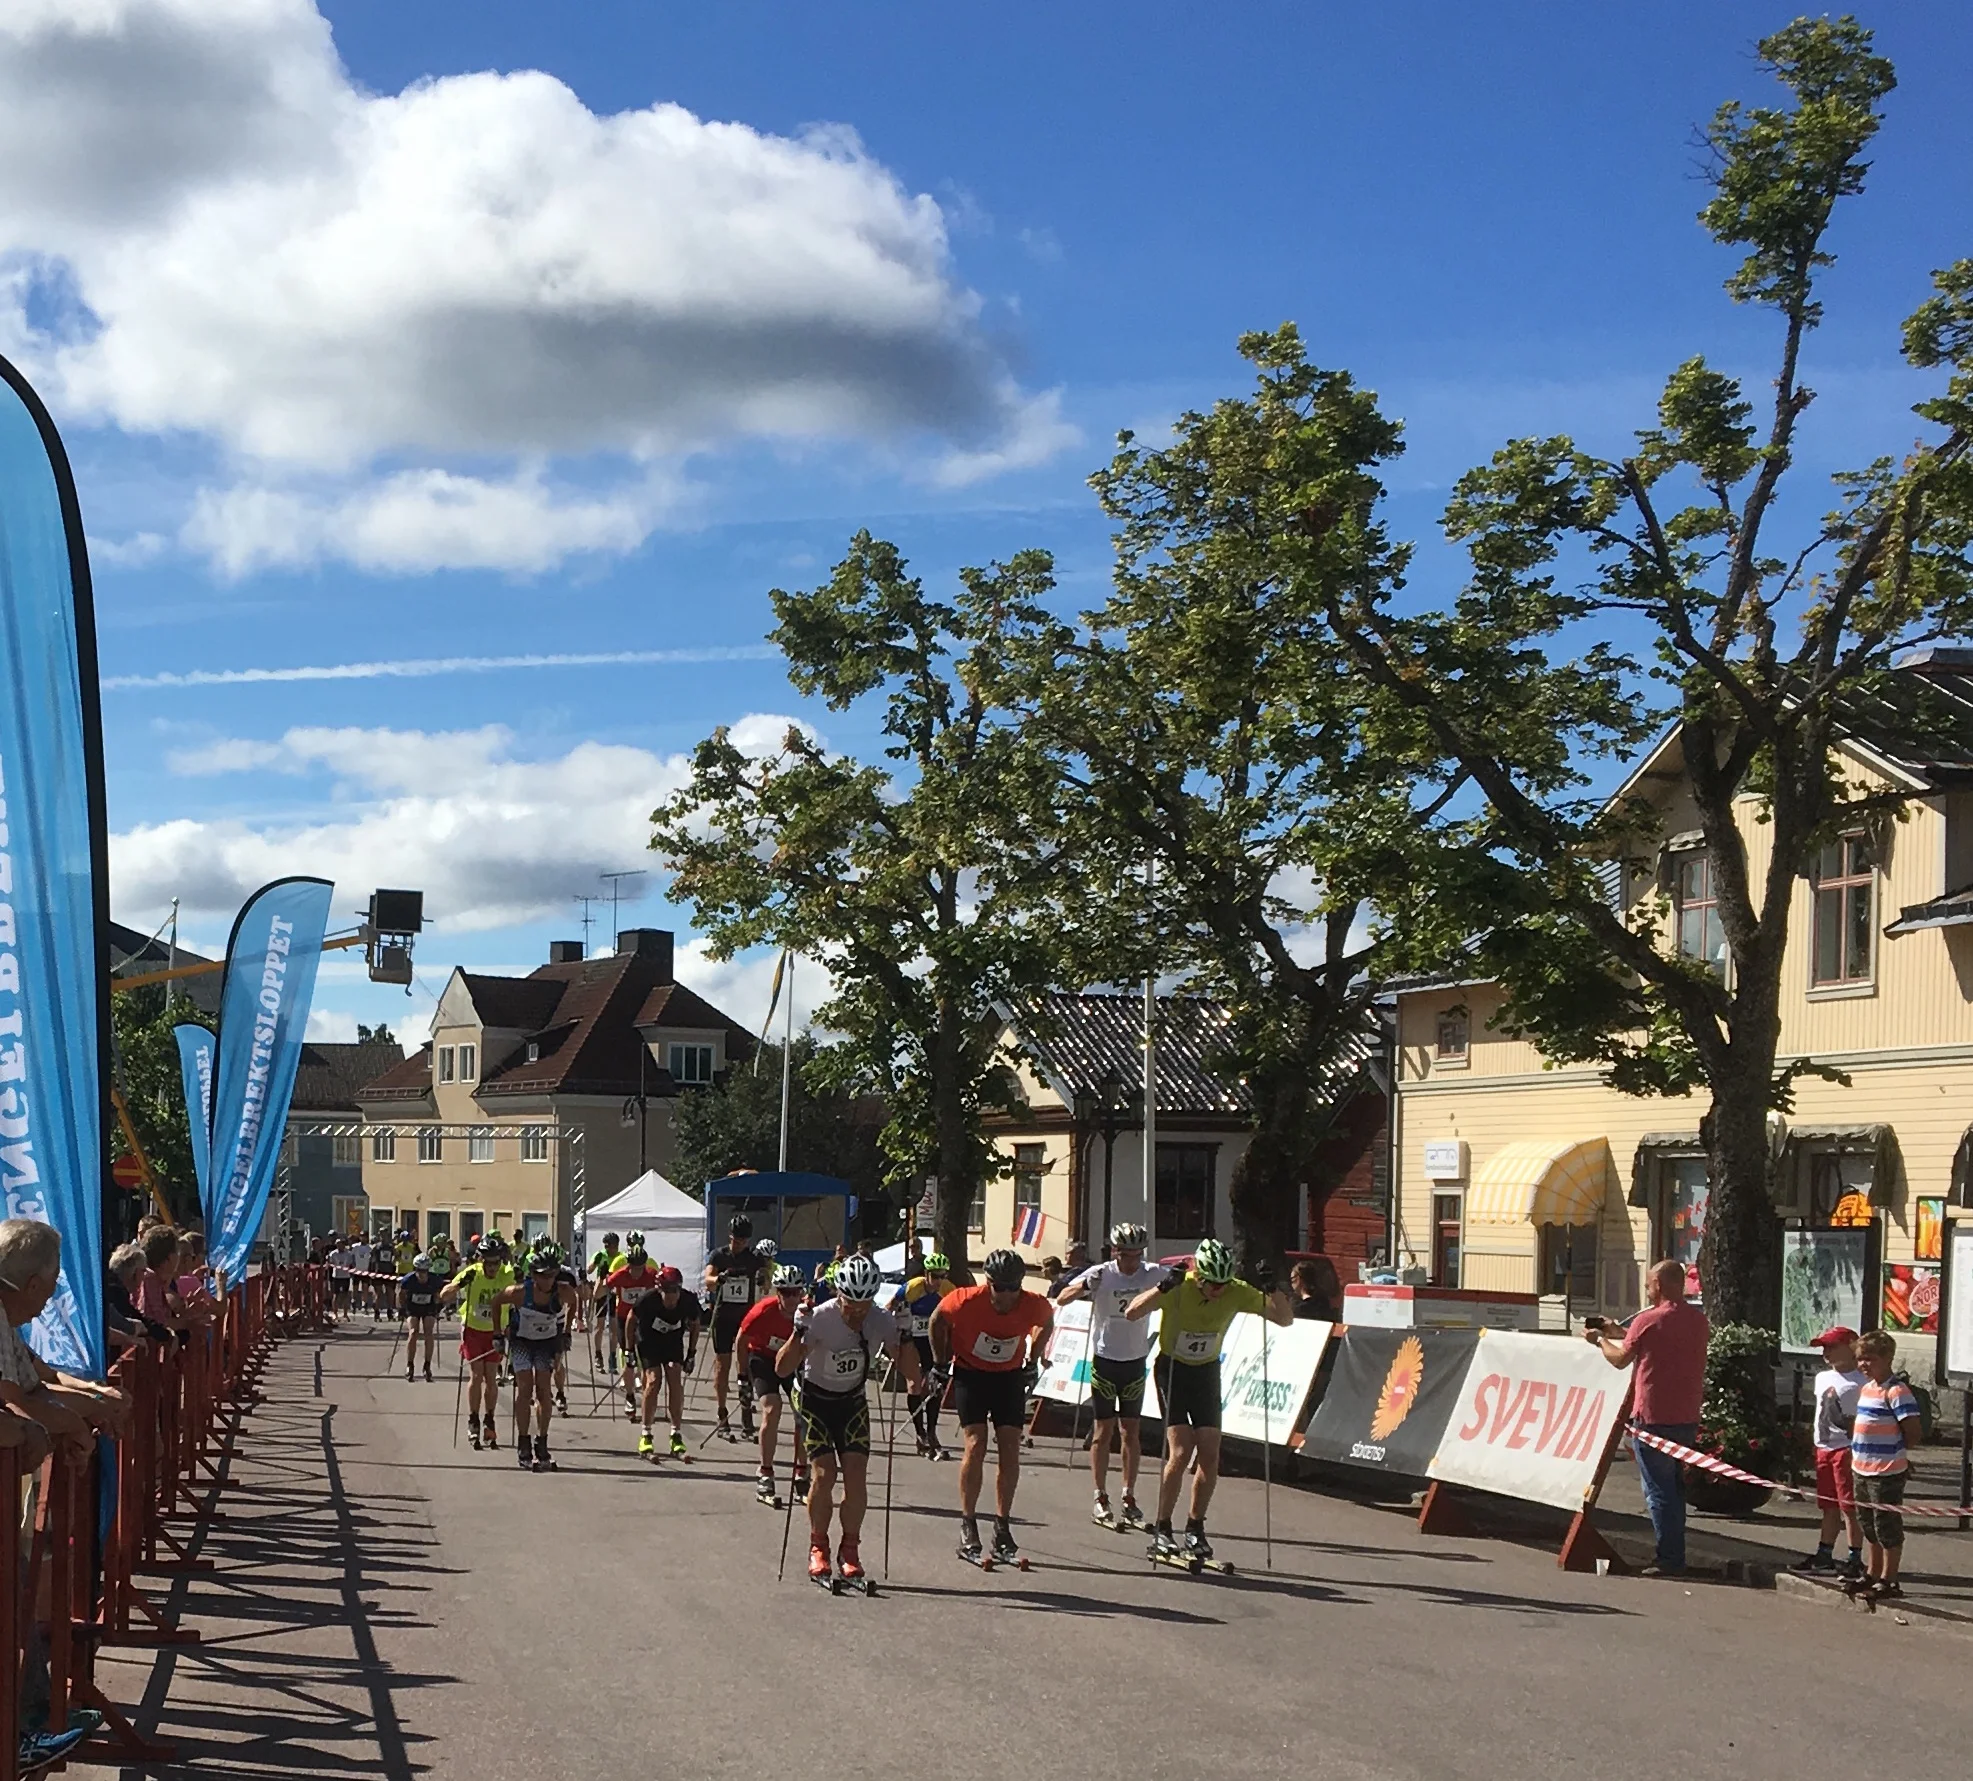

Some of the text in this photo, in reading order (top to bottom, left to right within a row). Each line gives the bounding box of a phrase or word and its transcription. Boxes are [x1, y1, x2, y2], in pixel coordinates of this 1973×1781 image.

[222, 914, 294, 1236] ENGELBREKTSLOPPET
[729, 1285, 743, 1296] 14
[990, 1344, 1002, 1355] 5
[1187, 1340, 1207, 1353] 41
[836, 1358, 858, 1374] 30
[1243, 1378, 1292, 1413] EXPRESS
[1459, 1373, 1606, 1462] SVEVIA
